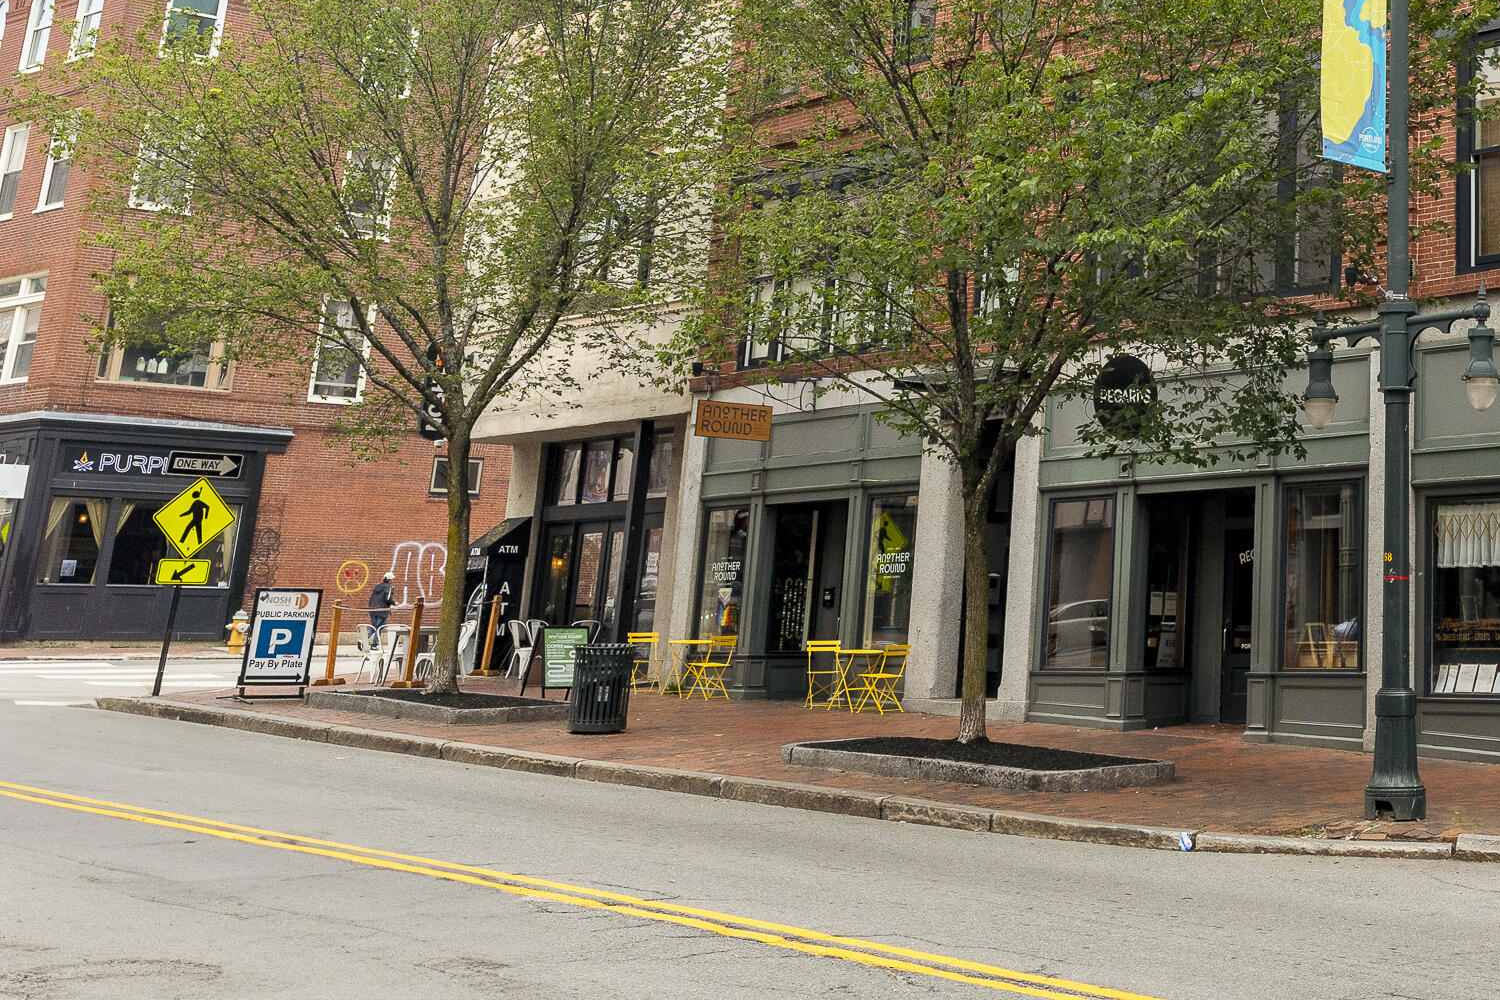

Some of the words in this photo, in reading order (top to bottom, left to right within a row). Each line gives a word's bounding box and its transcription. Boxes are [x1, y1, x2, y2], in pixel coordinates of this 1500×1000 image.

[701, 419, 752, 435] ROUND
[176, 458, 197, 468] ONE
[200, 459, 221, 469] WAY
[498, 545, 519, 554] ATM
[879, 563, 906, 573] ROUND
[713, 571, 737, 581] ROUND
[283, 611, 315, 619] PARKING
[248, 660, 266, 669] Pay
[267, 660, 280, 669] By
[281, 660, 303, 668] Plate
